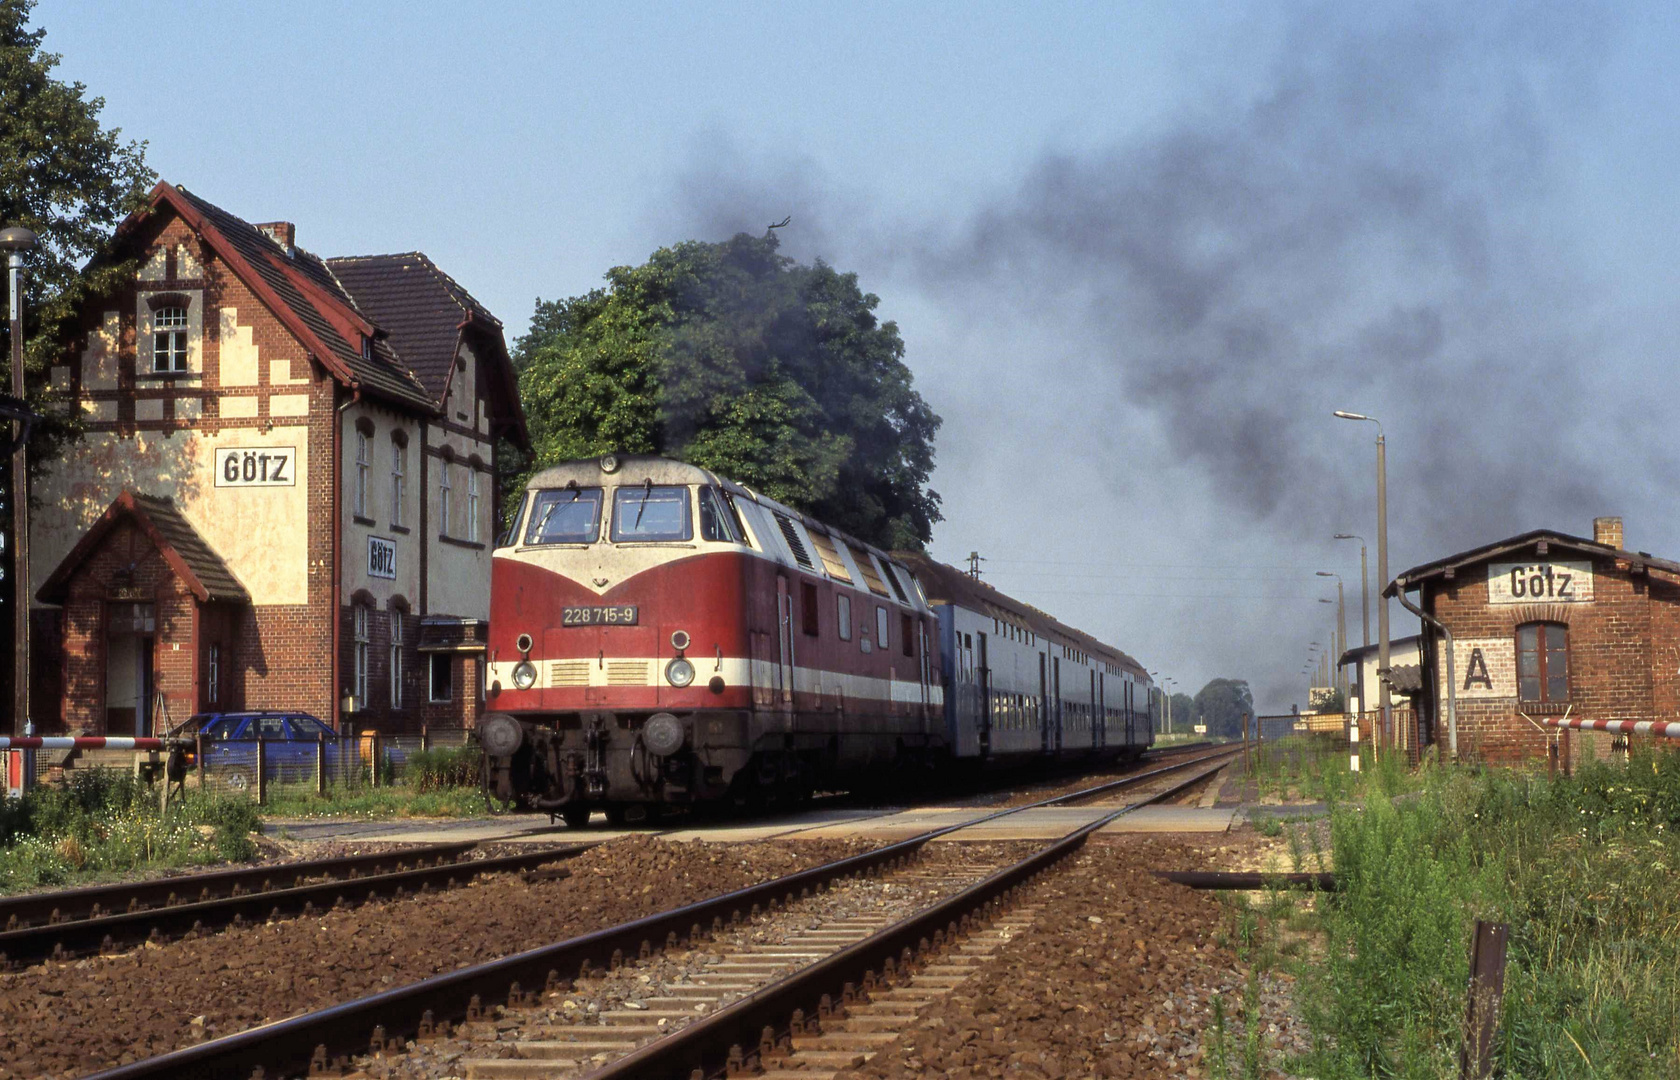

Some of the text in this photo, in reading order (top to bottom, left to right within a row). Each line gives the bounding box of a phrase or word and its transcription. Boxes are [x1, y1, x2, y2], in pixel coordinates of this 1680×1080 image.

[224, 451, 288, 482] GÖTZ
[371, 541, 394, 574] GÖTZ
[1511, 566, 1573, 598] Götz
[564, 607, 633, 623] 228 715-9
[1463, 647, 1493, 690] A
